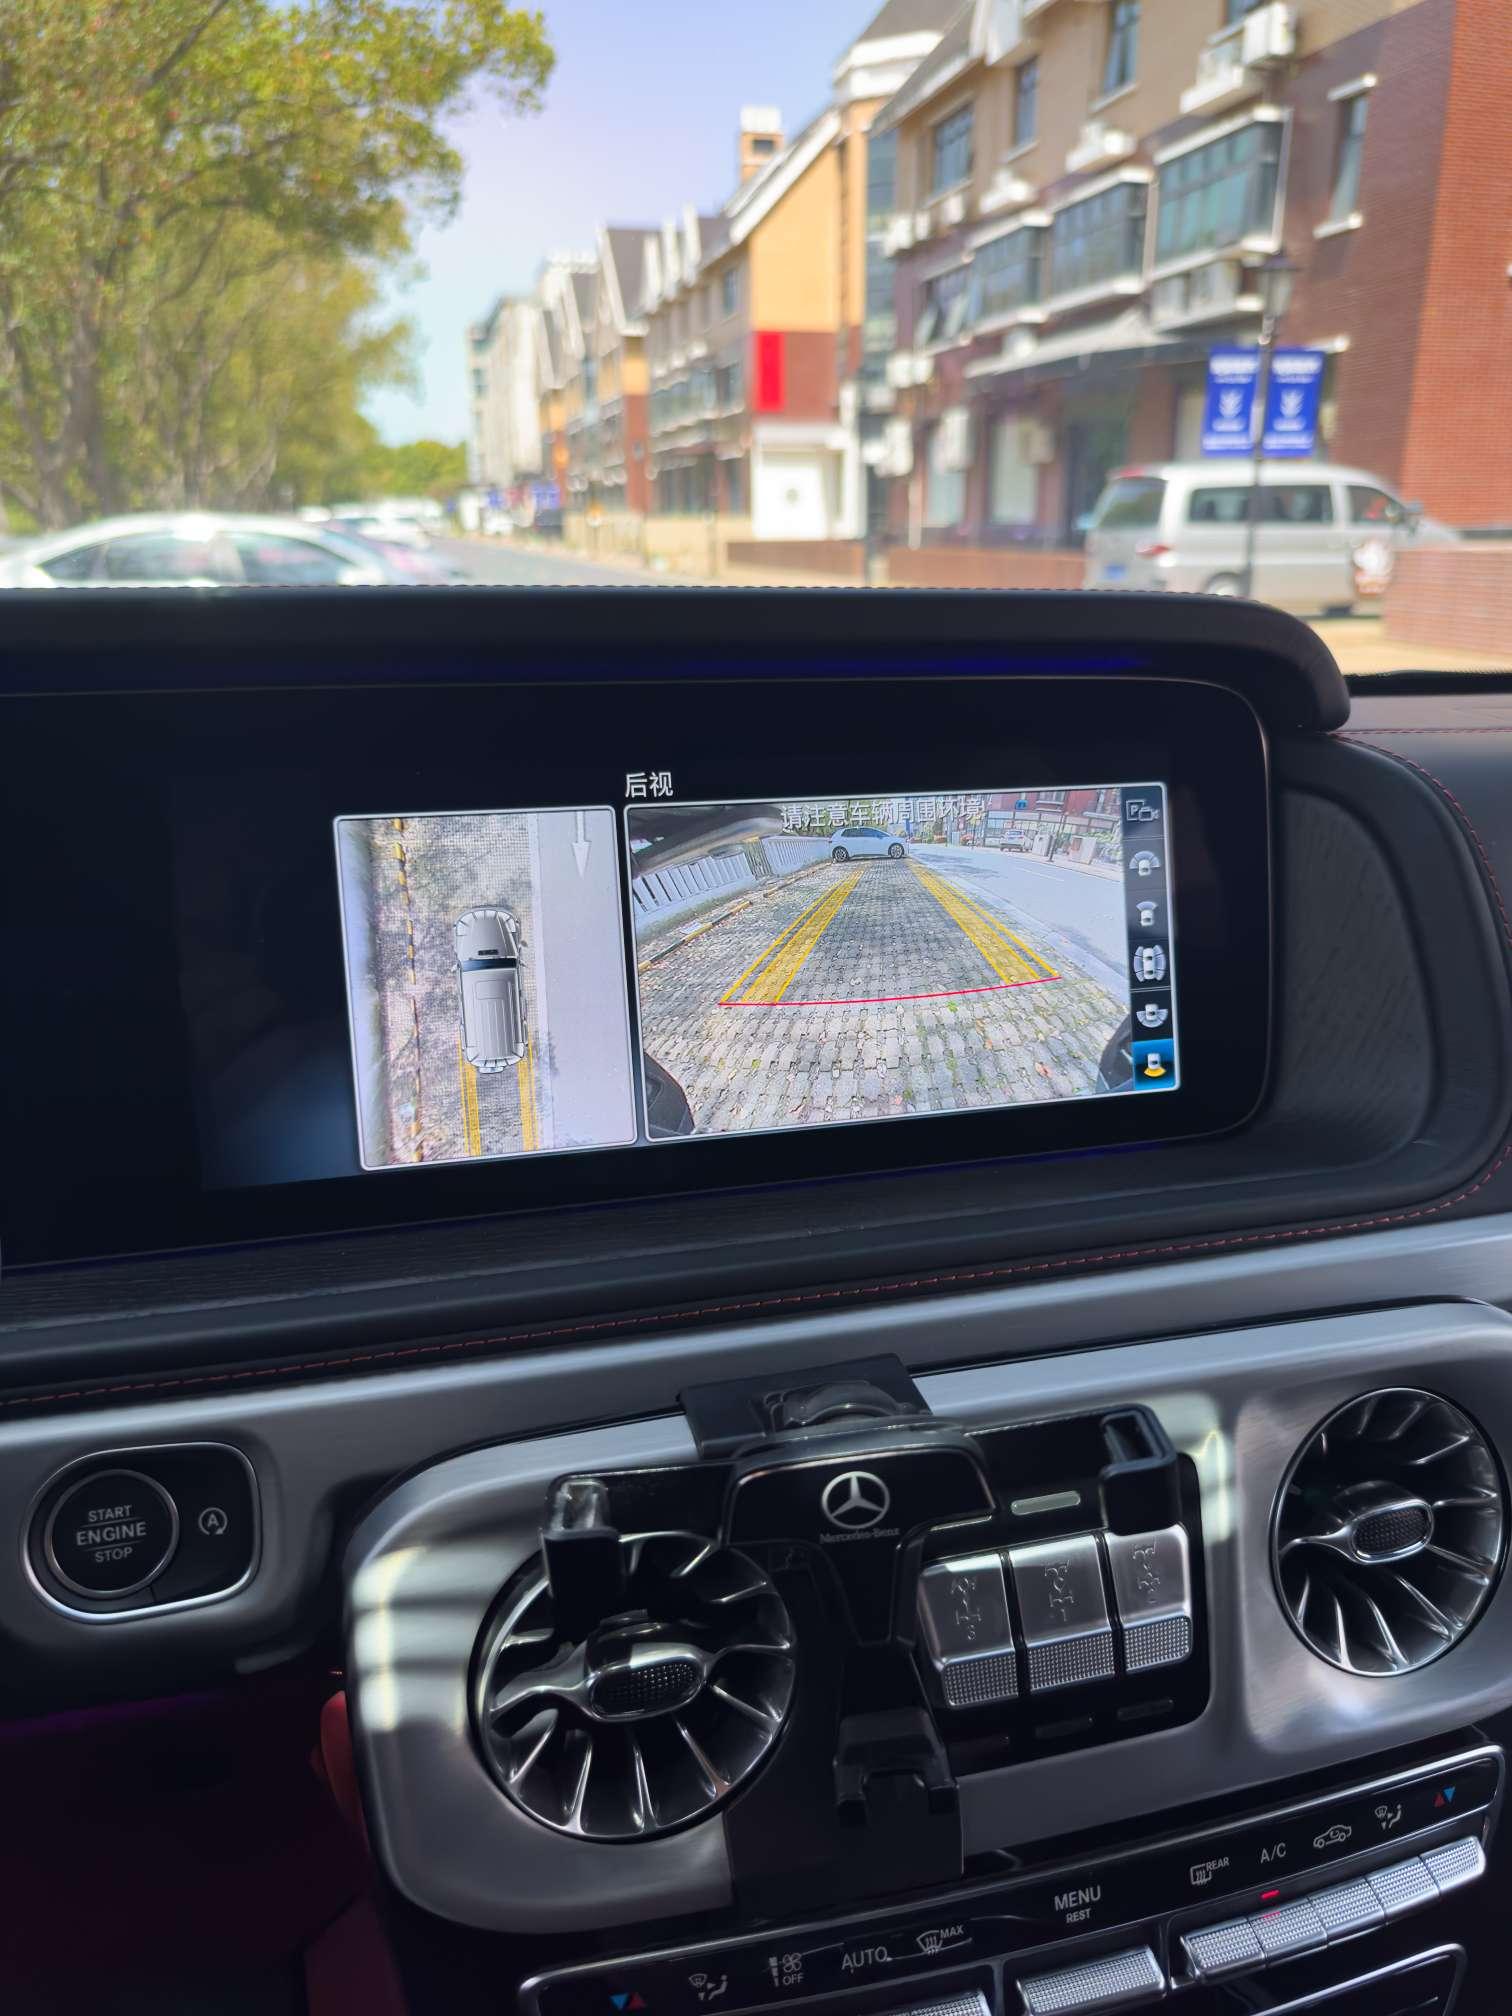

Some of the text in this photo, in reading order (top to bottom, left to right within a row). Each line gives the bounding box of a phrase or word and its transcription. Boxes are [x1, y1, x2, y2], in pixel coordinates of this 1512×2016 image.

[624, 772, 674, 798] 后视
[88, 1504, 132, 1522] START
[76, 1521, 147, 1546] ENGINE
[95, 1546, 133, 1563] STOP
[1260, 1842, 1287, 1864] A/C
[1205, 1856, 1230, 1872] REAR
[1054, 1885, 1101, 1911] MENU
[1066, 1908, 1092, 1924] REST
[939, 1925, 965, 1940] MAX
[841, 1946, 888, 1970] AUTO
[782, 1973, 804, 1986] OFF
